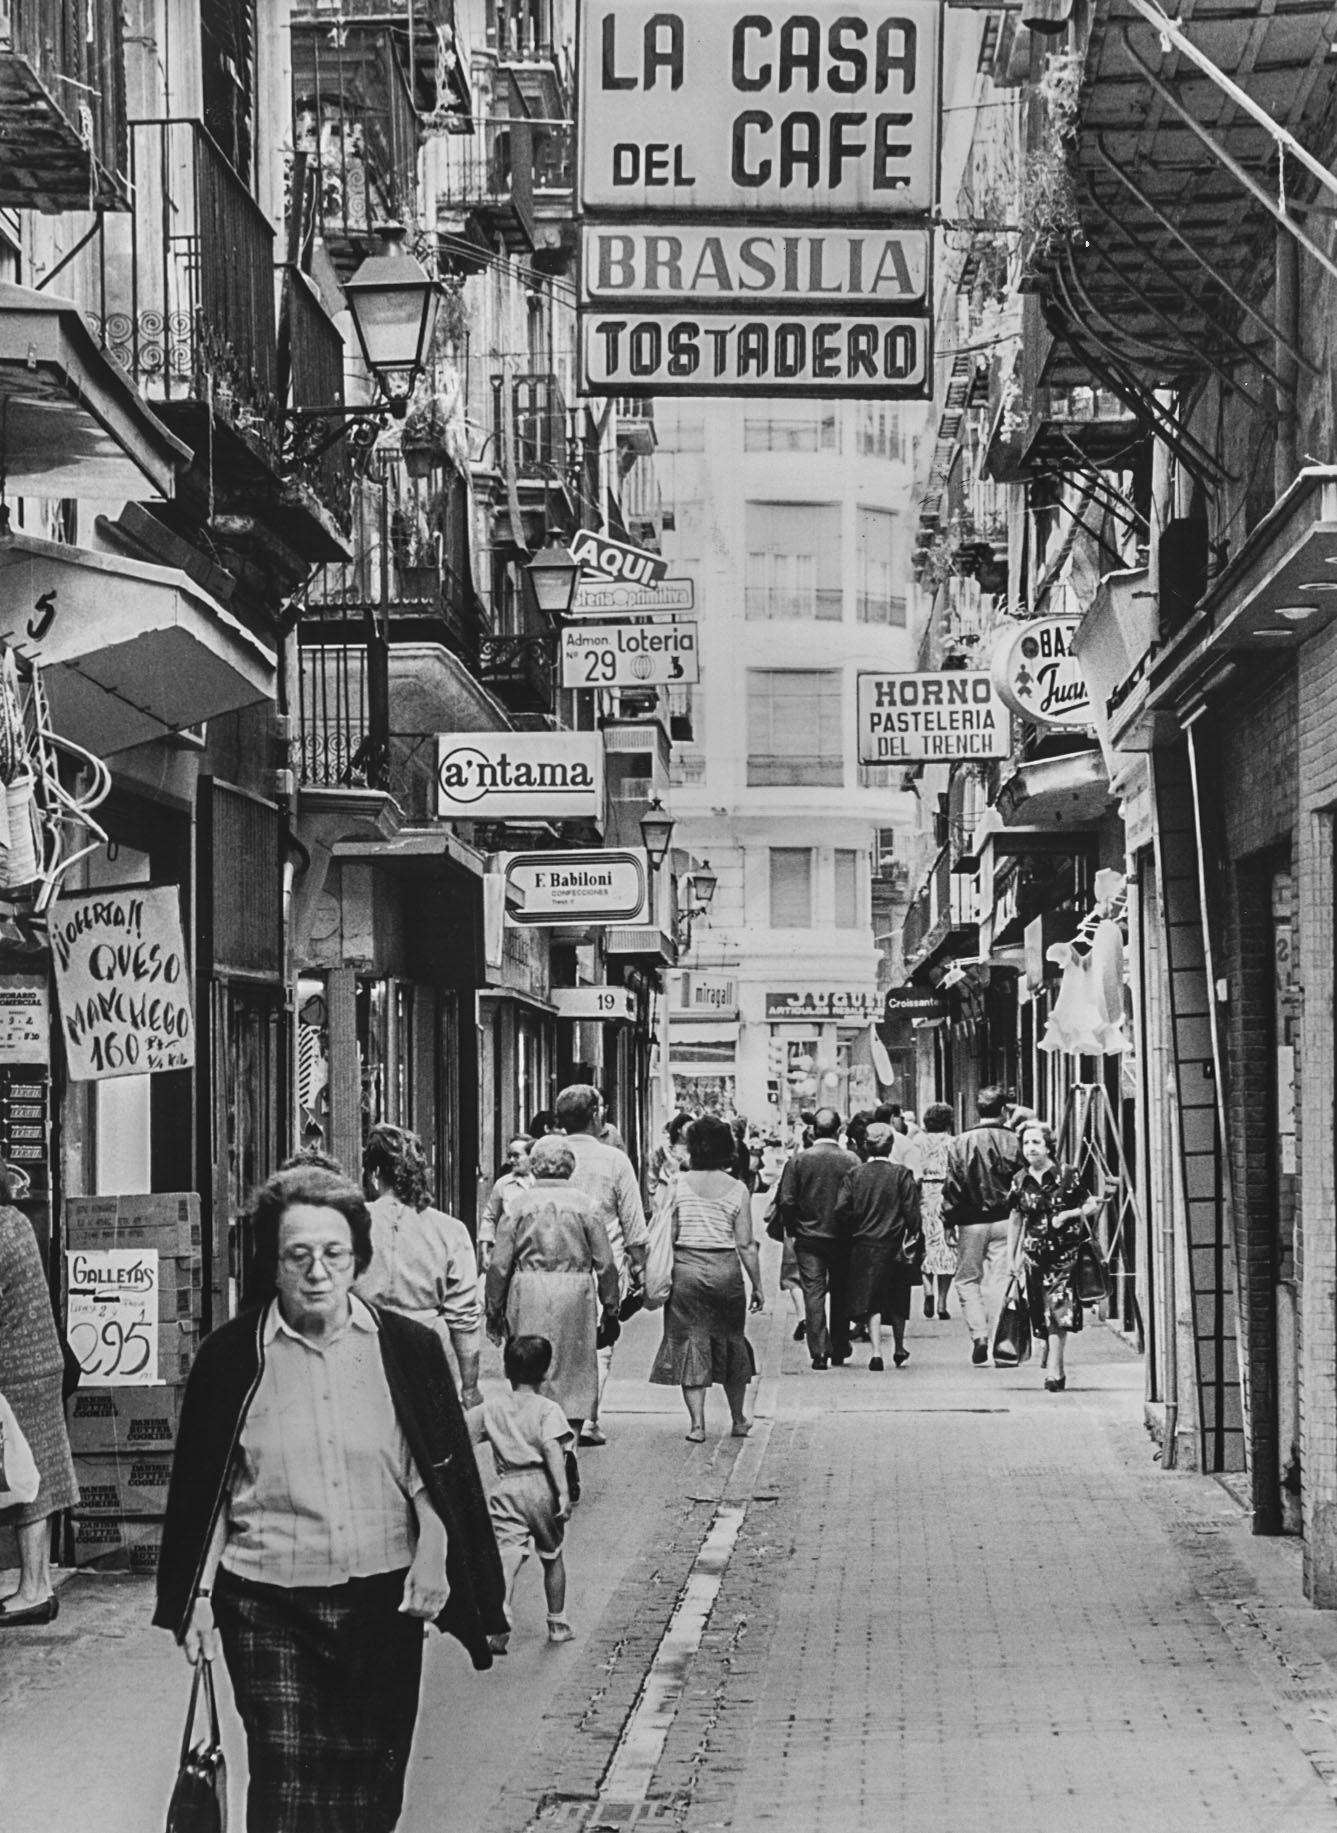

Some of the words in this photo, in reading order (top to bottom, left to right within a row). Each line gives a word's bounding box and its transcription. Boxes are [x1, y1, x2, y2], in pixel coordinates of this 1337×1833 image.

[602, 13, 684, 92] LA
[732, 14, 917, 94] CASA
[613, 142, 696, 187] DEL
[731, 110, 913, 190] CAFE
[597, 234, 920, 294] BRASILIA
[596, 321, 917, 379] TOSTADERO
[27, 590, 57, 639] 5
[617, 627, 693, 653] loteria
[584, 650, 617, 682] 29
[875, 678, 991, 707] HORNO
[870, 709, 996, 733] PASTELERIA
[878, 737, 911, 756] DEL
[921, 733, 993, 755] TRENCH
[550, 871, 612, 887] Babiloni
[89, 942, 180, 984] QUESO
[598, 994, 615, 1010] 19
[696, 982, 733, 1009] miragall
[66, 987, 189, 1046] MANCHEGO
[768, 1006, 830, 1016] ARTICULOS
[90, 1032, 139, 1071] 160
[71, 1321, 152, 1376] 295
[126, 1432, 173, 1441] COOKIES
[129, 1426, 170, 1434] BUTTER
[75, 1535, 121, 1544] COOKIES
